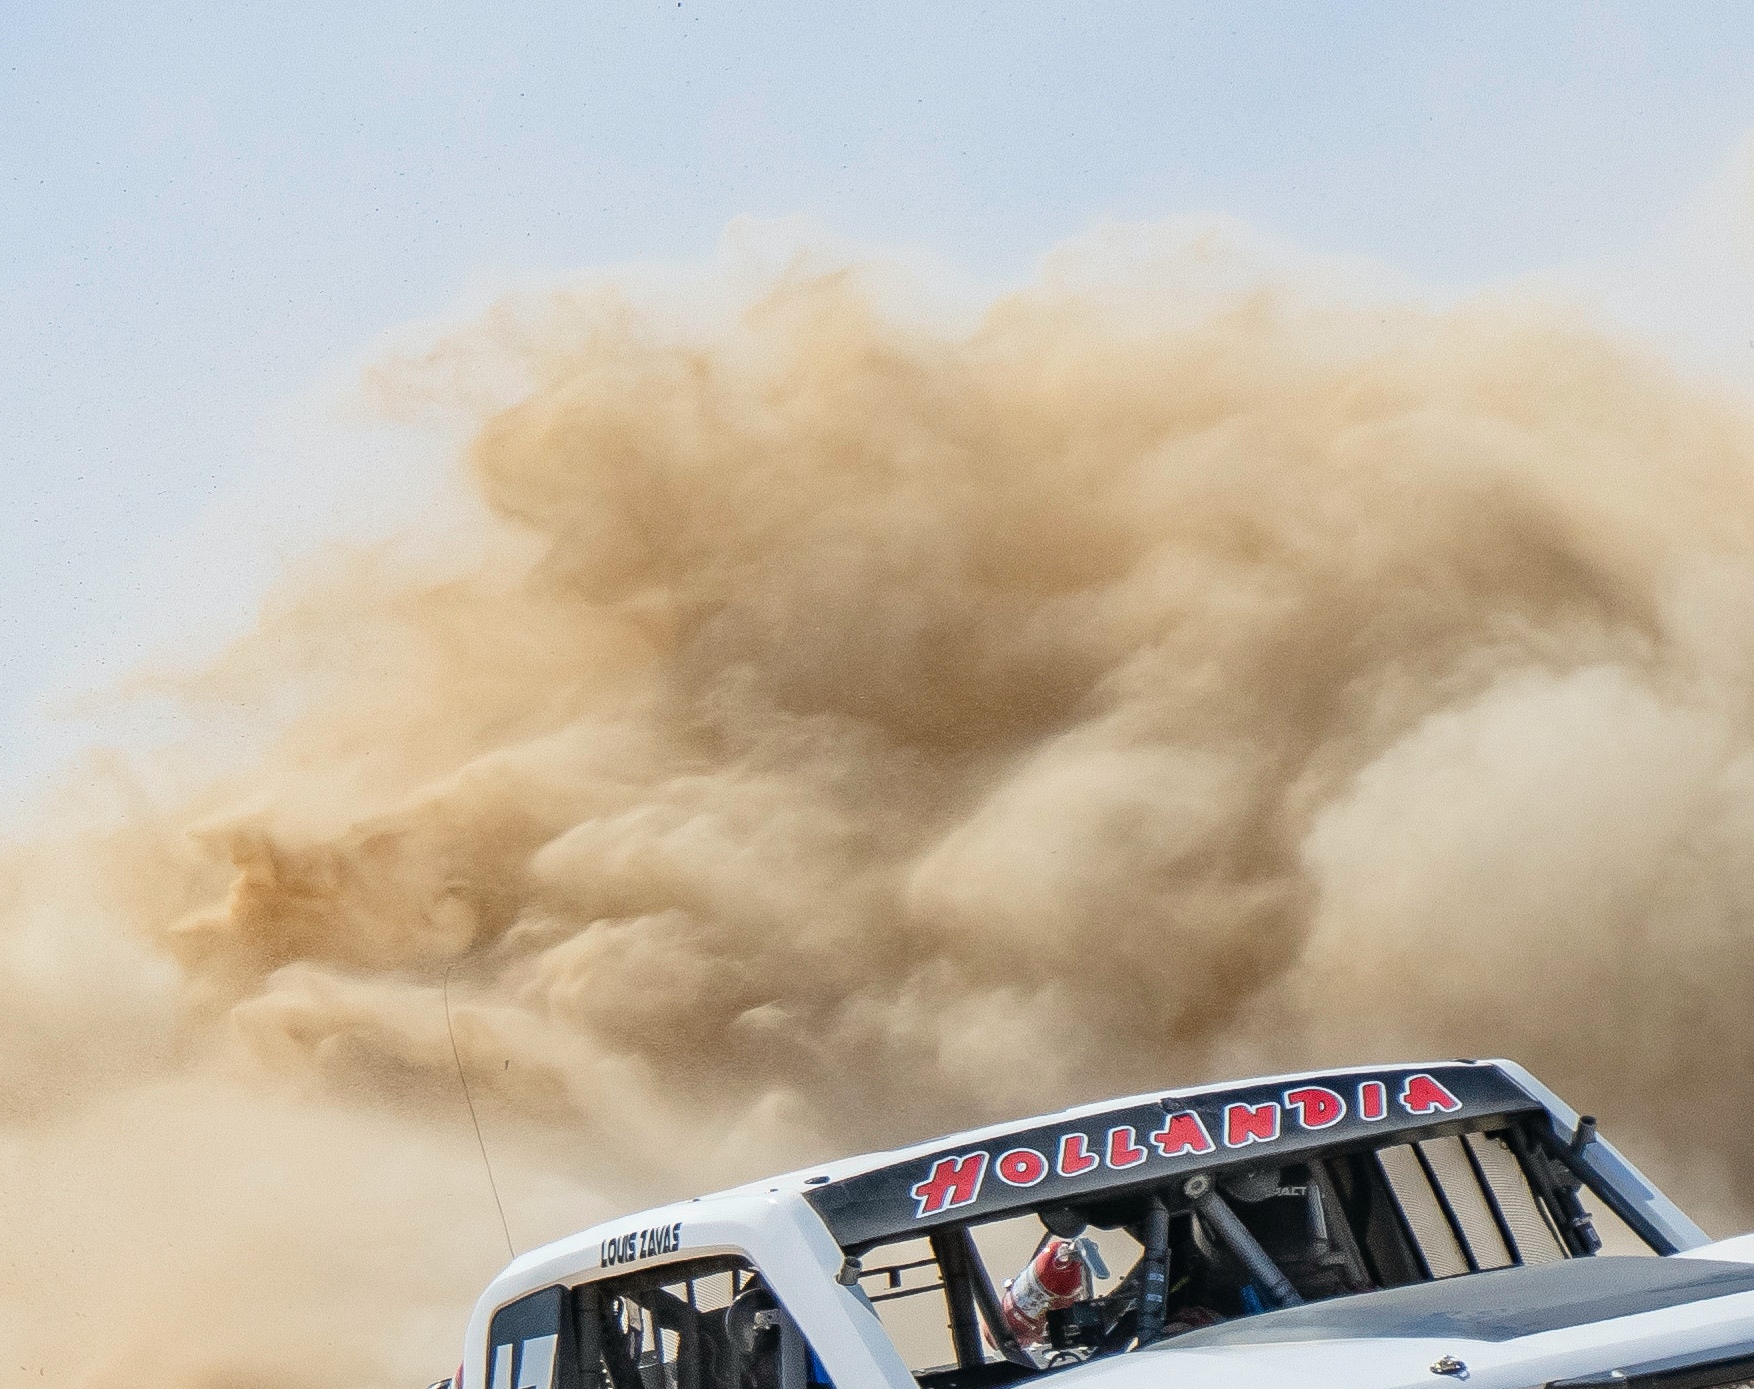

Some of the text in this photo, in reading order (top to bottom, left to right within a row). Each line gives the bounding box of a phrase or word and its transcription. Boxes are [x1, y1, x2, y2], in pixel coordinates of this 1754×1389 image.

[912, 1074, 1463, 1218] HOLLANDIA
[600, 1221, 683, 1268] LOUIS ZAVAS
